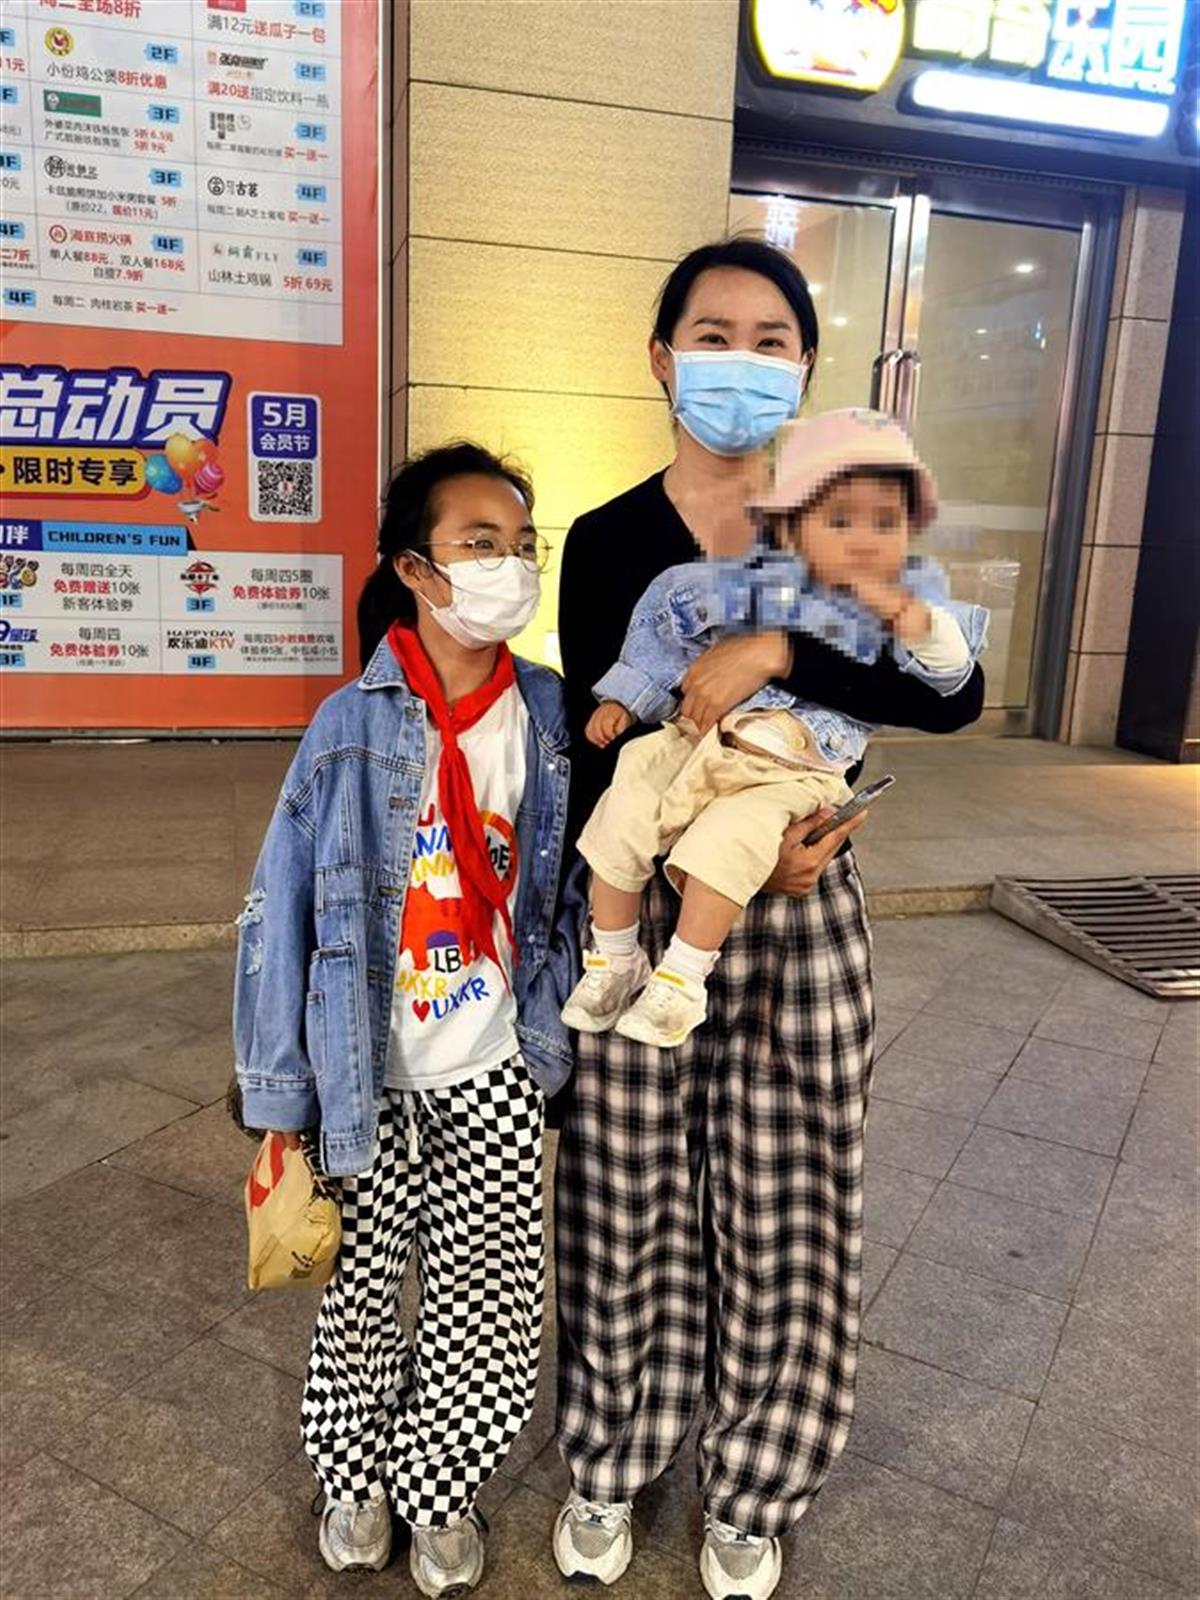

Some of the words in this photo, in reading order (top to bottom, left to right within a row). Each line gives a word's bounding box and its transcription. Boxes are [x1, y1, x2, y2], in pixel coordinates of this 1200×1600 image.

[208, 14, 326, 43] 满12元送瓜子一包
[151, 46, 176, 61] 2F
[47, 62, 167, 89] 小份鸡公煲8折优惠
[300, 64, 324, 79] 2F
[152, 107, 176, 121] 3F
[300, 125, 324, 139] 3F
[284, 146, 328, 161] 买一送一
[153, 171, 178, 185] 3F
[301, 186, 324, 200] 4F
[287, 211, 330, 225] 买一送一
[70, 228, 133, 247] 海底捞火锅
[157, 238, 181, 252] 4F
[301, 250, 324, 264] 4F
[305, 277, 333, 293] 69元
[9, 290, 32, 304] 4F
[136, 301, 178, 316] 买一送一
[0, 371, 224, 442] 总动员
[263, 402, 307, 428] 5月
[259, 433, 311, 453] 会员节
[0, 524, 29, 545] 伴
[48, 531, 142, 546] CHILDREN'S
[150, 534, 180, 547] FUN
[61, 562, 133, 579] 每周四全天
[54, 579, 141, 596] 免费赠送10张
[232, 585, 330, 601] 免费体验券10张
[62, 596, 133, 612] 新客体验券
[191, 599, 212, 611] 3F
[79, 626, 121, 642] 每周四
[166, 629, 236, 638] HAPPYDAY
[50, 642, 149, 659] 免费体验券10张
[166, 637, 236, 651] 欢乐迪KTV
[192, 656, 213, 668] 4F
[434, 947, 462, 974] LB
[432, 976, 490, 1020] UXKR
